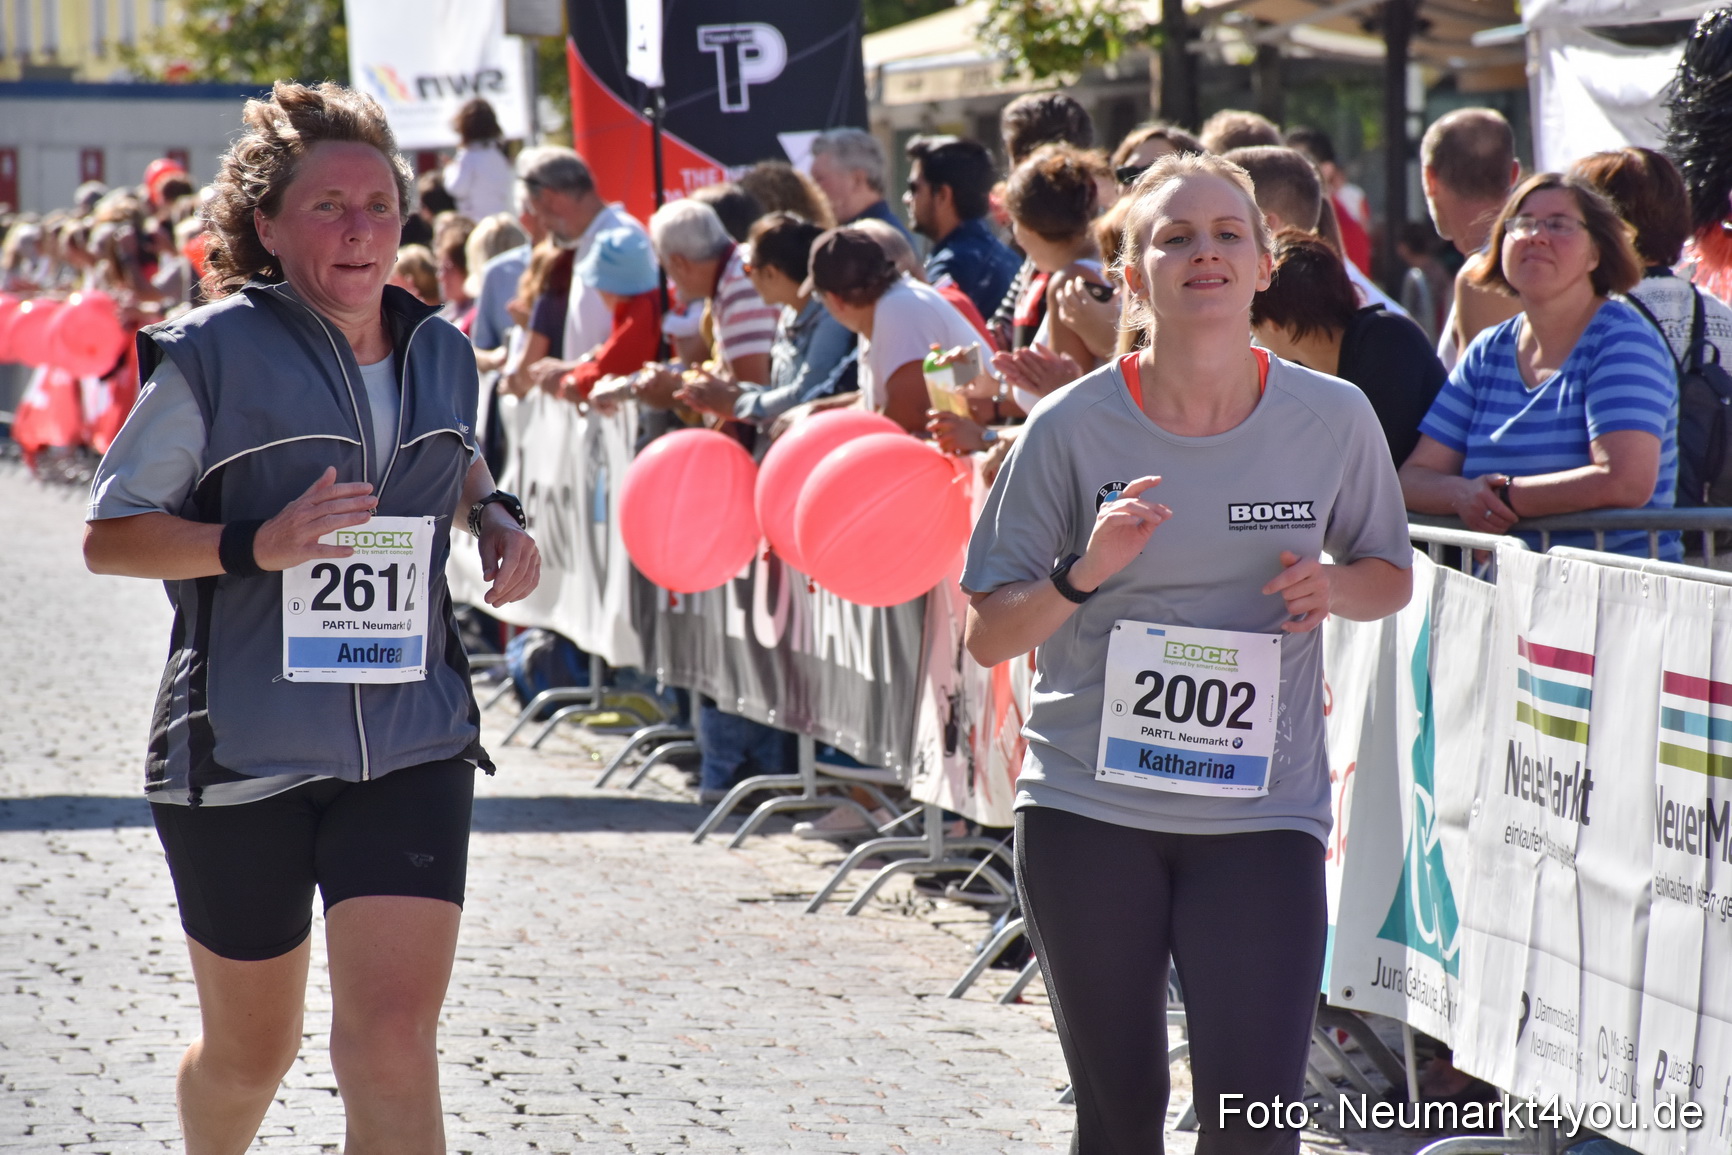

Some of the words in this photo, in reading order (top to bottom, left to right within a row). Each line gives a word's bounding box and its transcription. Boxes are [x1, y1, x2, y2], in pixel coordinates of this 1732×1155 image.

[697, 22, 788, 113] TP
[1228, 501, 1317, 524] BOCK
[1229, 524, 1258, 532] inspired
[1259, 524, 1268, 532] by
[337, 531, 413, 549] BOCK
[311, 562, 417, 612] 2612
[293, 602, 300, 611] D
[322, 620, 360, 630] PARTL
[362, 620, 405, 630] Neumarkt
[337, 643, 403, 663] Andrea
[1164, 641, 1239, 666] BOCK
[1163, 659, 1186, 667] inspired
[1214, 665, 1239, 673] concepts
[1116, 703, 1123, 713] D
[1132, 670, 1256, 730] 2002
[1141, 726, 1176, 740] PARTL
[1178, 732, 1228, 747] Neumarkt
[1139, 748, 1235, 780] Katharina
[1655, 870, 1693, 906] einkaufen
[1371, 957, 1403, 993] Jura
[1530, 1031, 1565, 1066] Neumarkt
